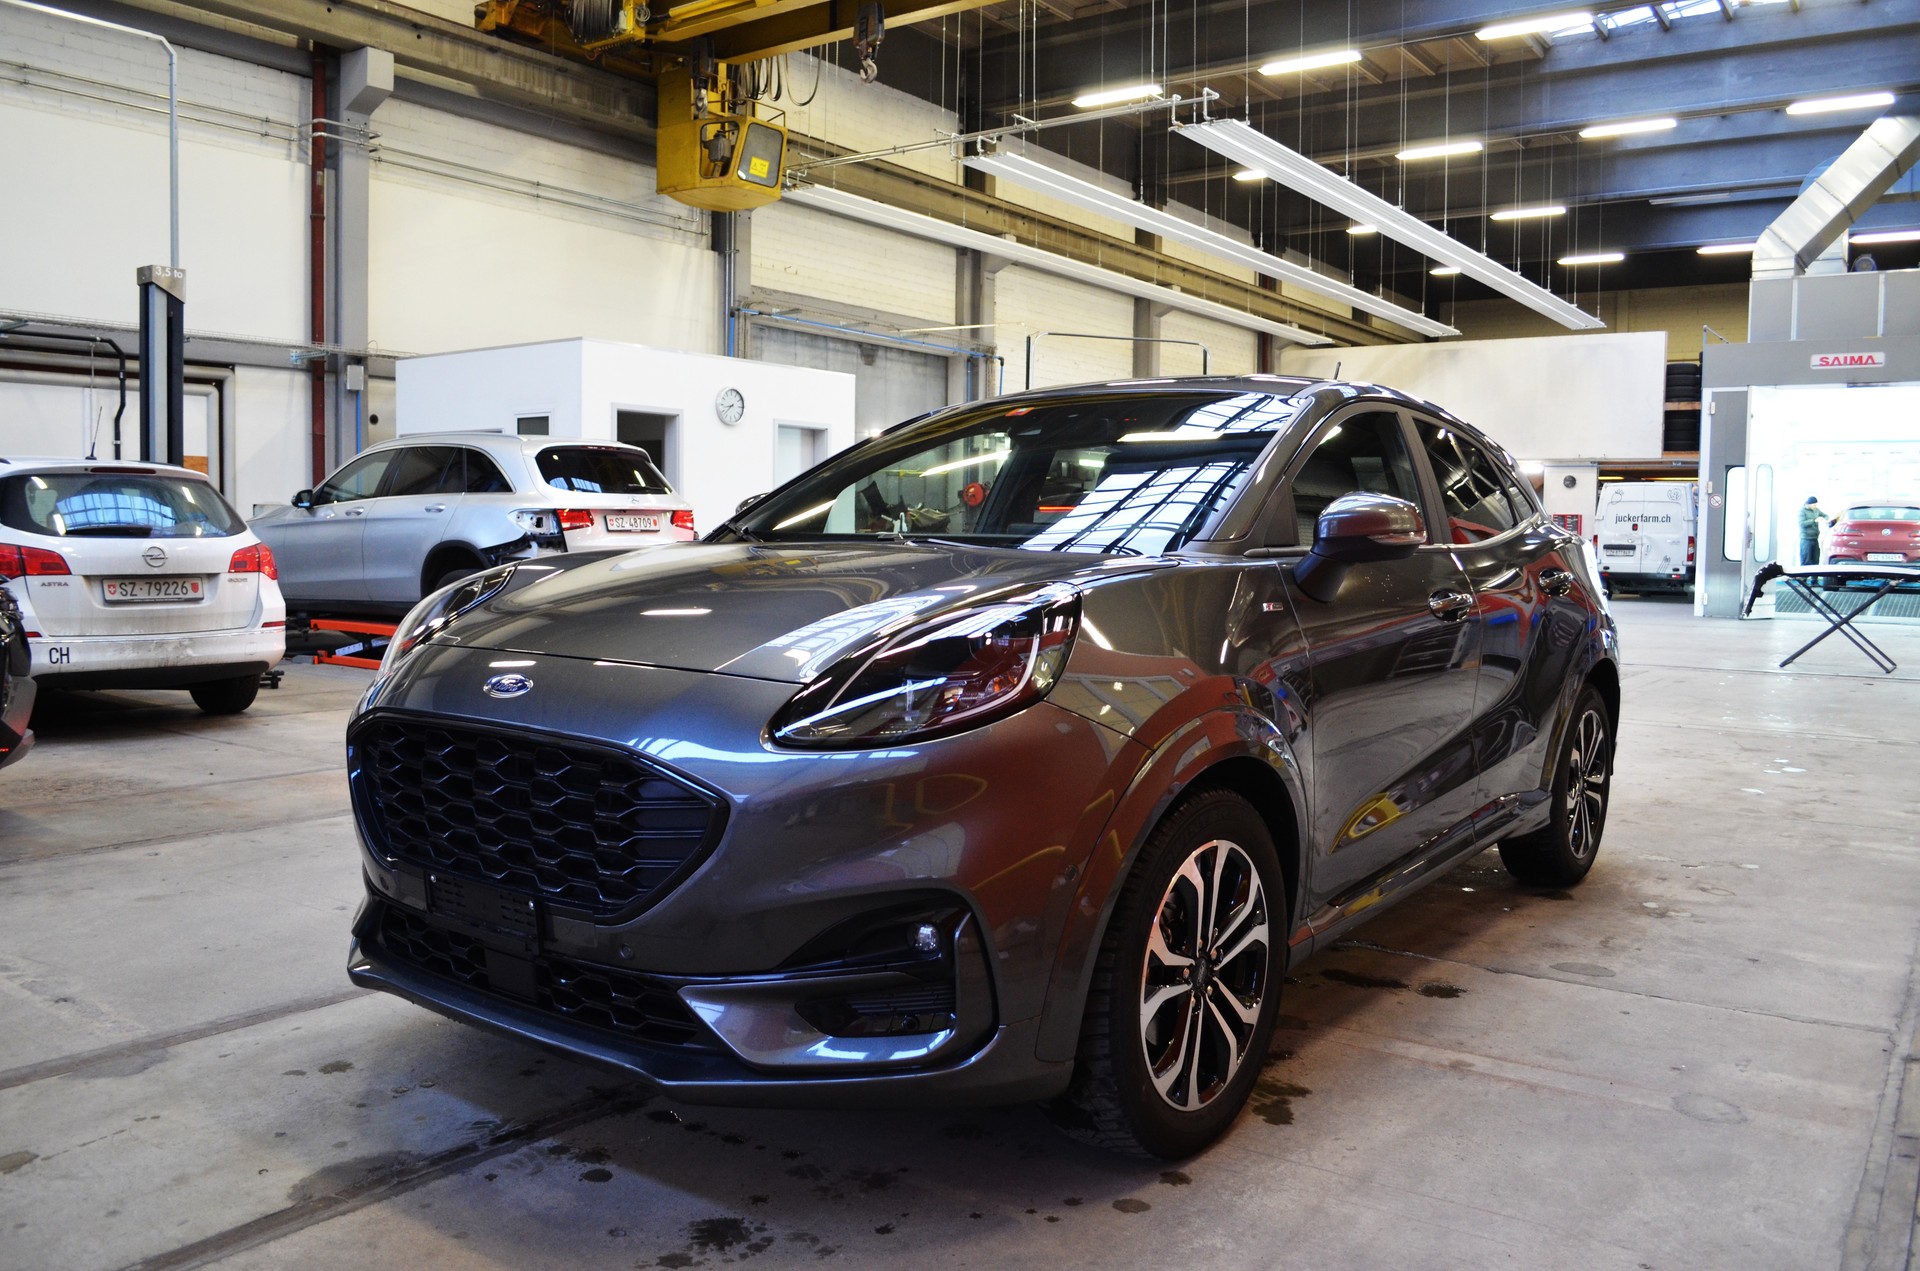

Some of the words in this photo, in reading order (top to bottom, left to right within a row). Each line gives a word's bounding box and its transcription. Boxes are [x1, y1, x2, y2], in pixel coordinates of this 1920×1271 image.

[155, 266, 171, 277] 3,5
[174, 269, 183, 279] to
[1818, 354, 1876, 367] SAIMA
[1615, 513, 1671, 524] juckerfarm.ch
[49, 647, 70, 664] CH
